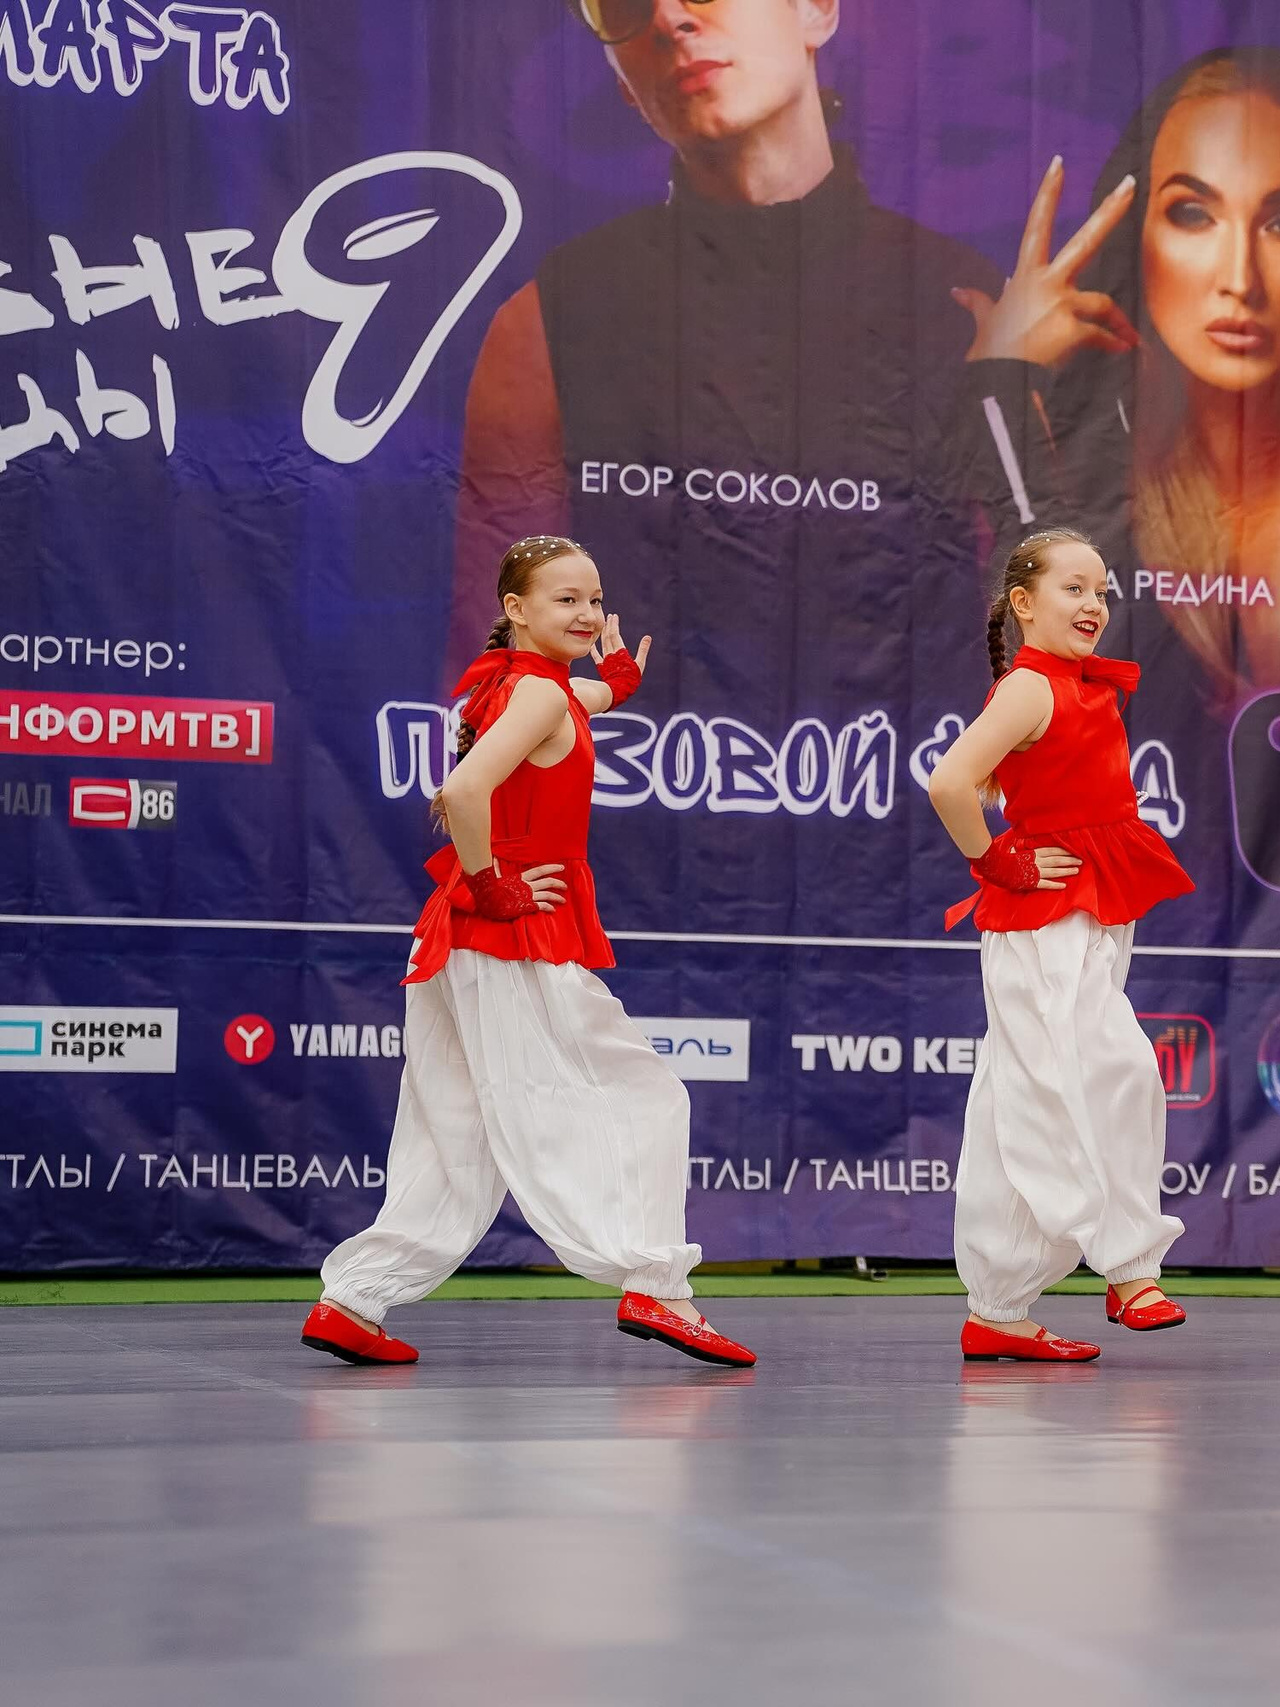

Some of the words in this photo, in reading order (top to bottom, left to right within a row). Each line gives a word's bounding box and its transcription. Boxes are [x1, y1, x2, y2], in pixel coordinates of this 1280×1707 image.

[581, 460, 674, 497] ЕГОР
[685, 468, 881, 511] СОКОЛОВ
[1134, 569, 1275, 607] РЕДИНА
[0, 633, 187, 677] артнер:
[375, 701, 898, 819] ПЗОВОЙ
[51, 1018, 162, 1038] синема
[289, 1023, 406, 1058] YAMAG
[644, 1036, 733, 1056] аль
[51, 1039, 126, 1062] парк
[791, 1034, 902, 1073] TWO
[0, 1153, 92, 1189] ТЛЫ
[139, 1153, 386, 1192] ТАНЦЕВАЛЬ
[809, 1158, 957, 1196] ТАНЦЕВ
